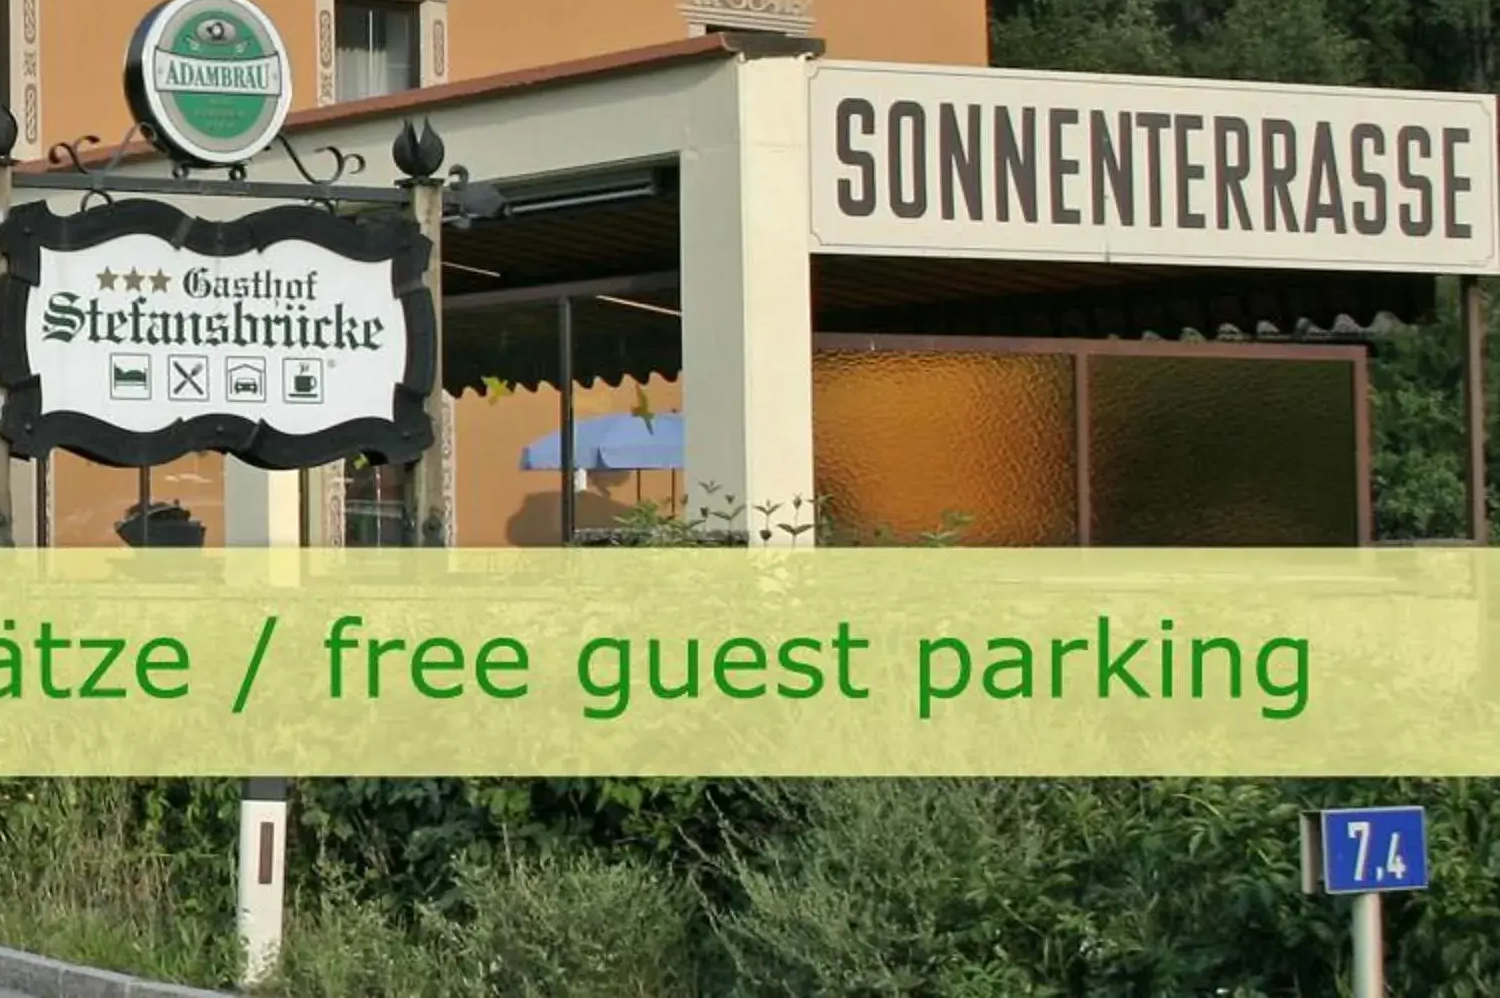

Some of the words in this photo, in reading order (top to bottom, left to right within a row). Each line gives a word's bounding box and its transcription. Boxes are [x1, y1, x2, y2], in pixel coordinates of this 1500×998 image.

[835, 98, 1472, 239] SONNENTERRASSE
[183, 267, 319, 305] Gasthof
[42, 292, 385, 350] Stefansbrücke
